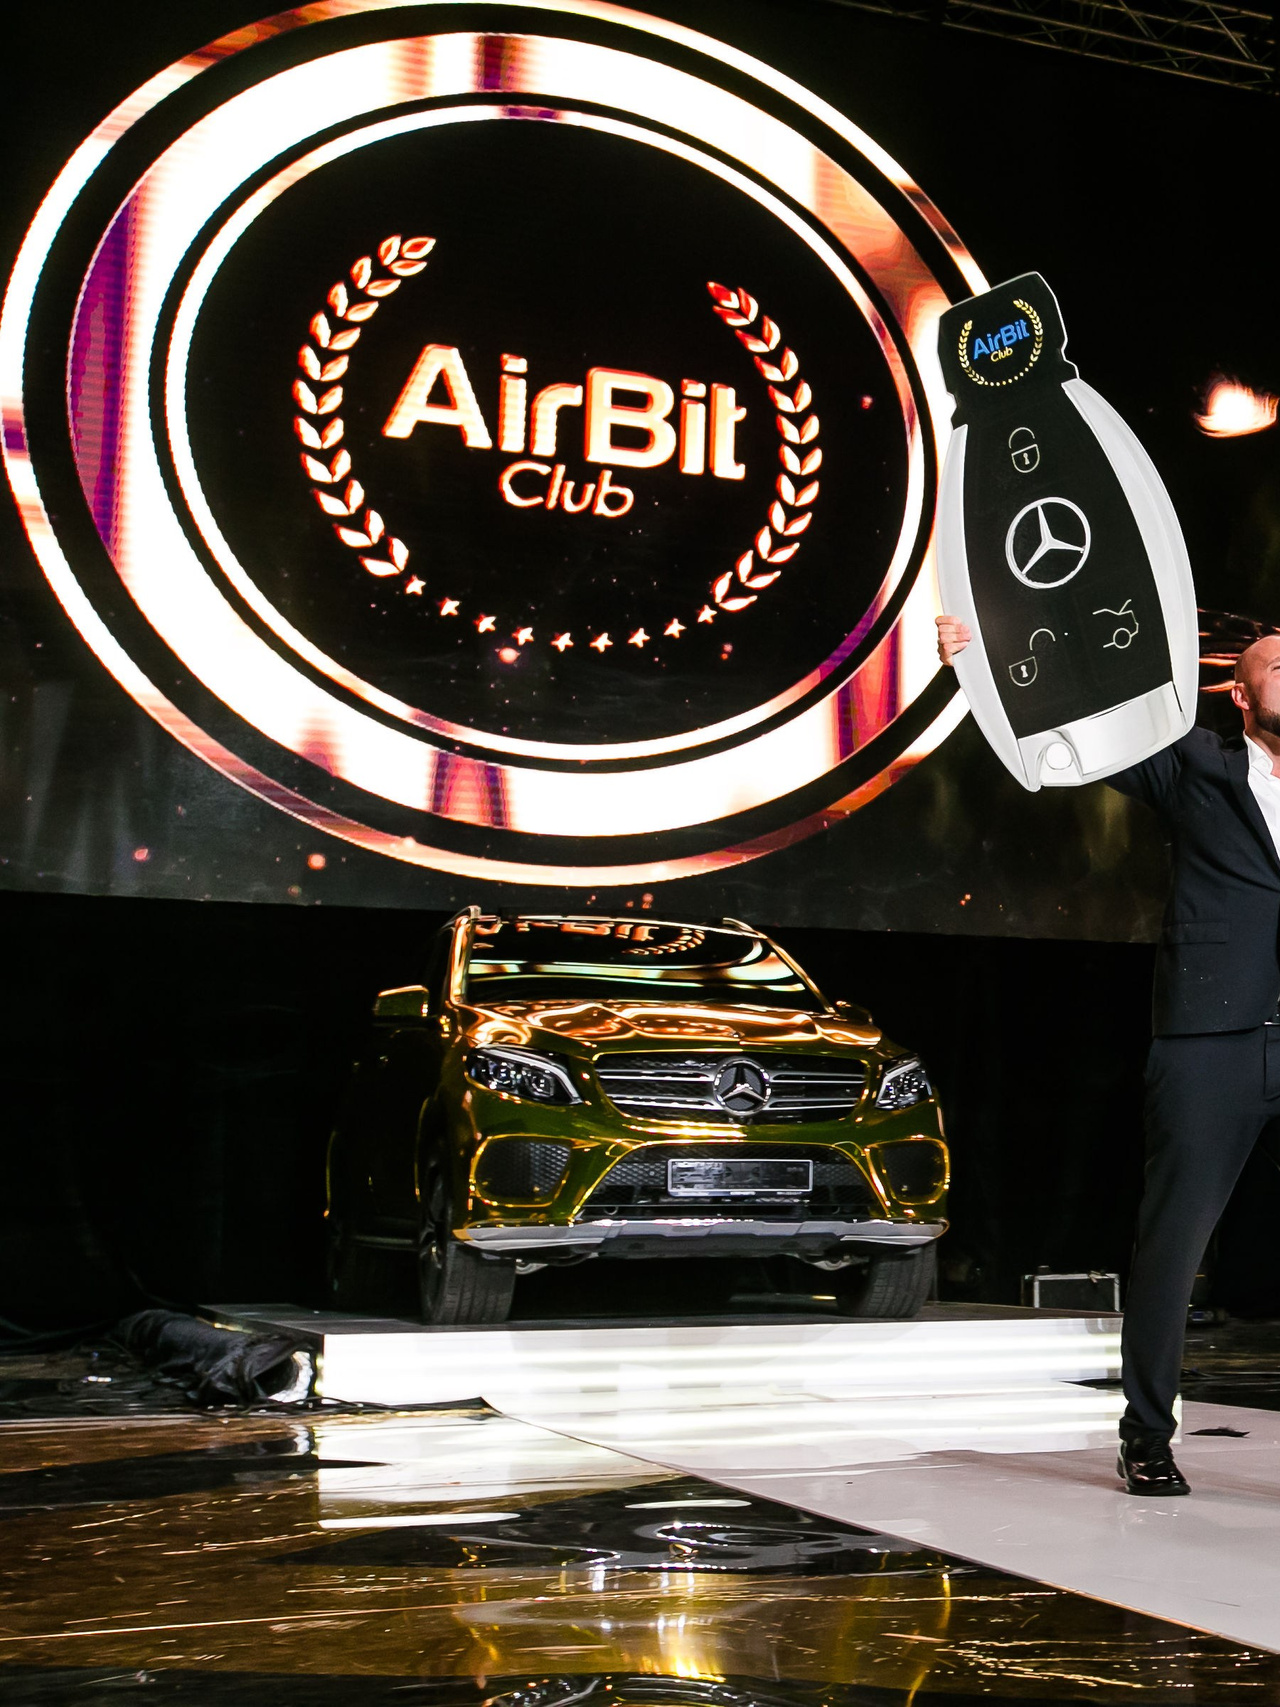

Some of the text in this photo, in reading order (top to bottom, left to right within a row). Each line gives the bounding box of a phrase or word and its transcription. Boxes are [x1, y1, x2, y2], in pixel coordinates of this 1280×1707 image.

[973, 319, 1030, 360] AirBit
[990, 347, 1013, 362] Club
[382, 343, 747, 480] AirBit
[499, 460, 635, 518] Club
